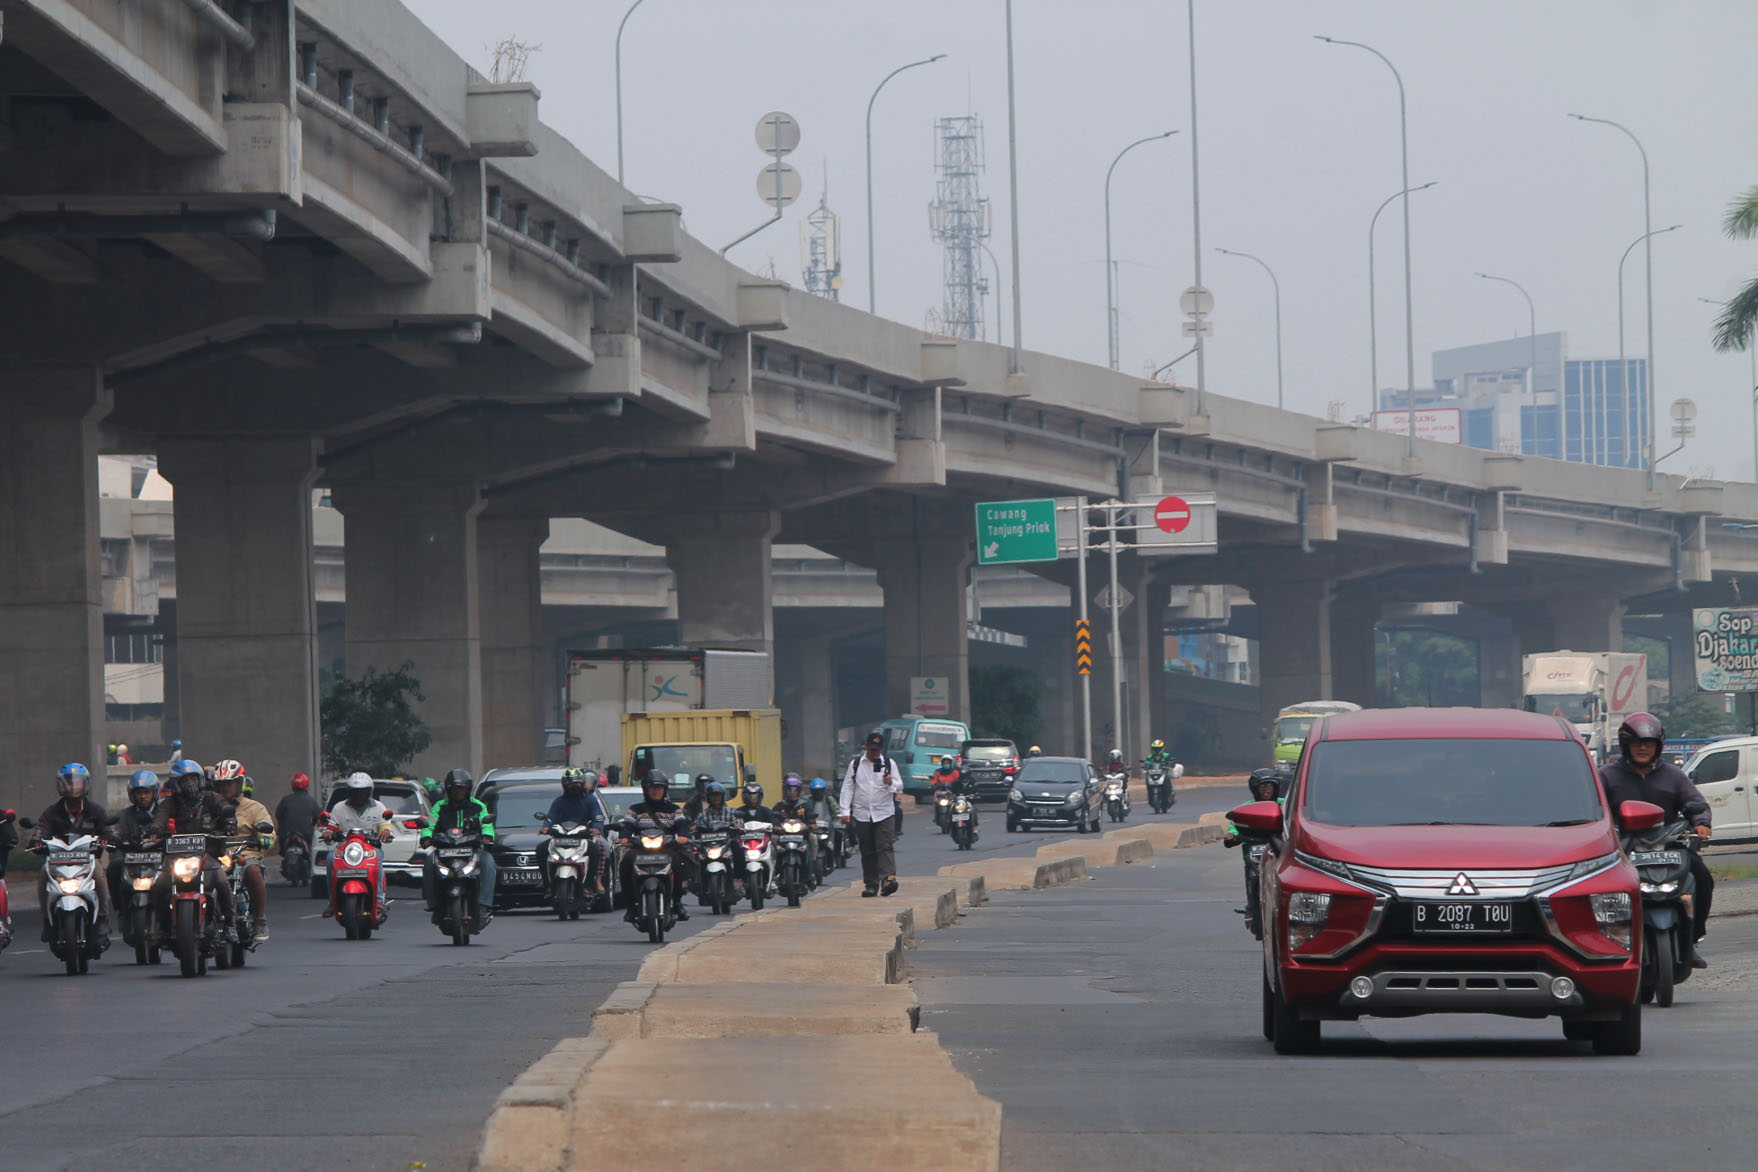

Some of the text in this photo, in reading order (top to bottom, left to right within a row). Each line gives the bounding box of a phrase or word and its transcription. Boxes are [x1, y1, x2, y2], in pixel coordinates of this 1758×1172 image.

[987, 509, 1027, 521] Cawang
[987, 521, 1050, 538] Tanjung Priok
[1719, 613, 1751, 634] Sop
[1417, 905, 1426, 921] B
[1438, 905, 1472, 921] 2087
